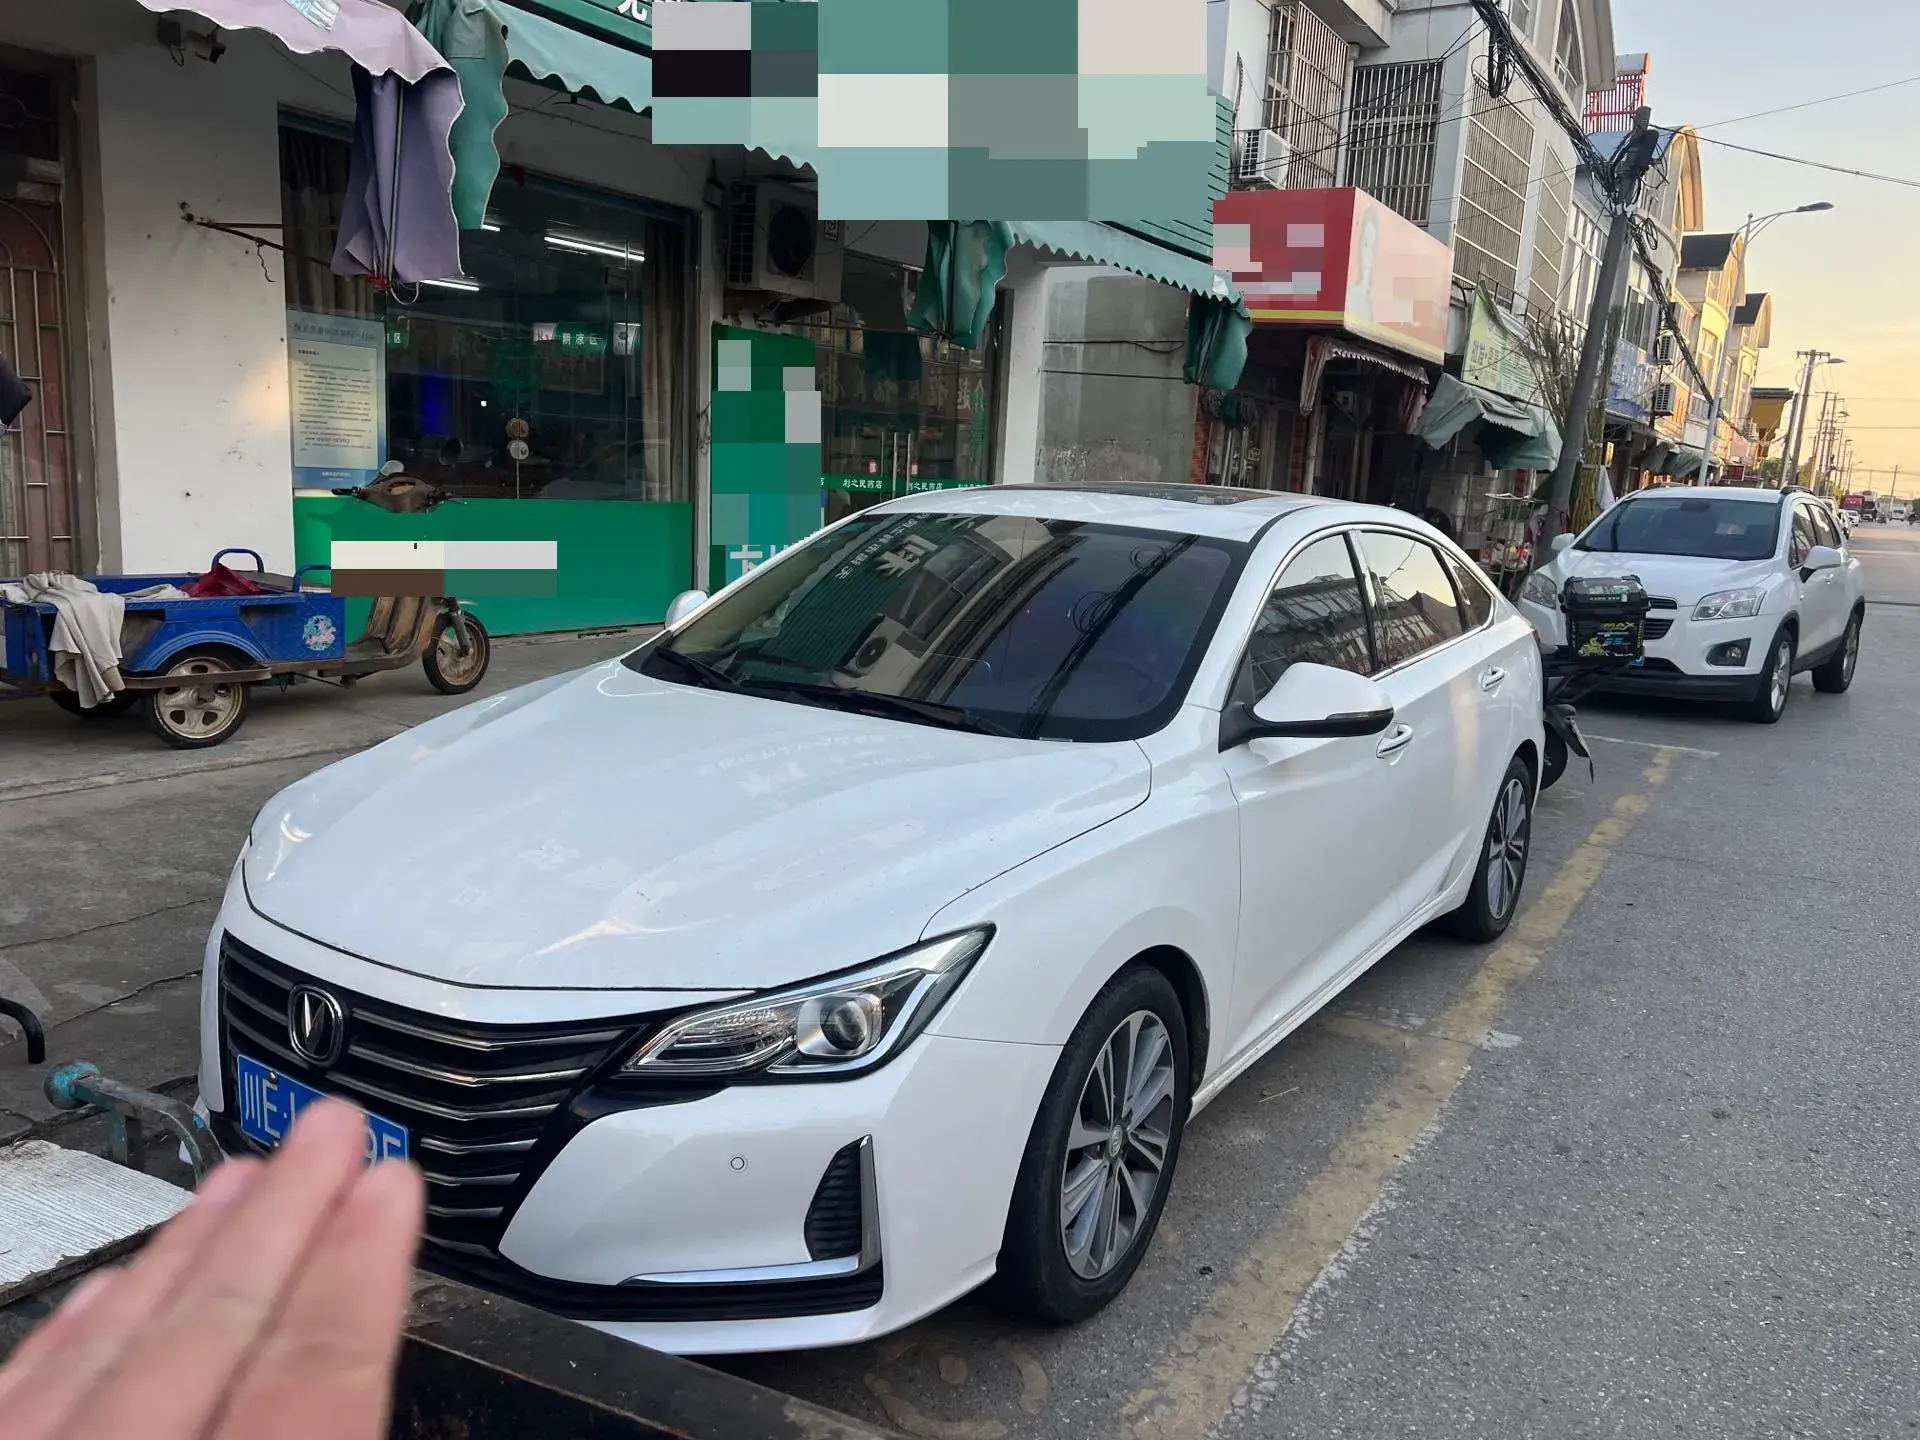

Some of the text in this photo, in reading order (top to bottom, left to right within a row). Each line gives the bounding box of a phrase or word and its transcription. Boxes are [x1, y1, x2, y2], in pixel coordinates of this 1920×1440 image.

[842, 478, 883, 489] 利之民药店
